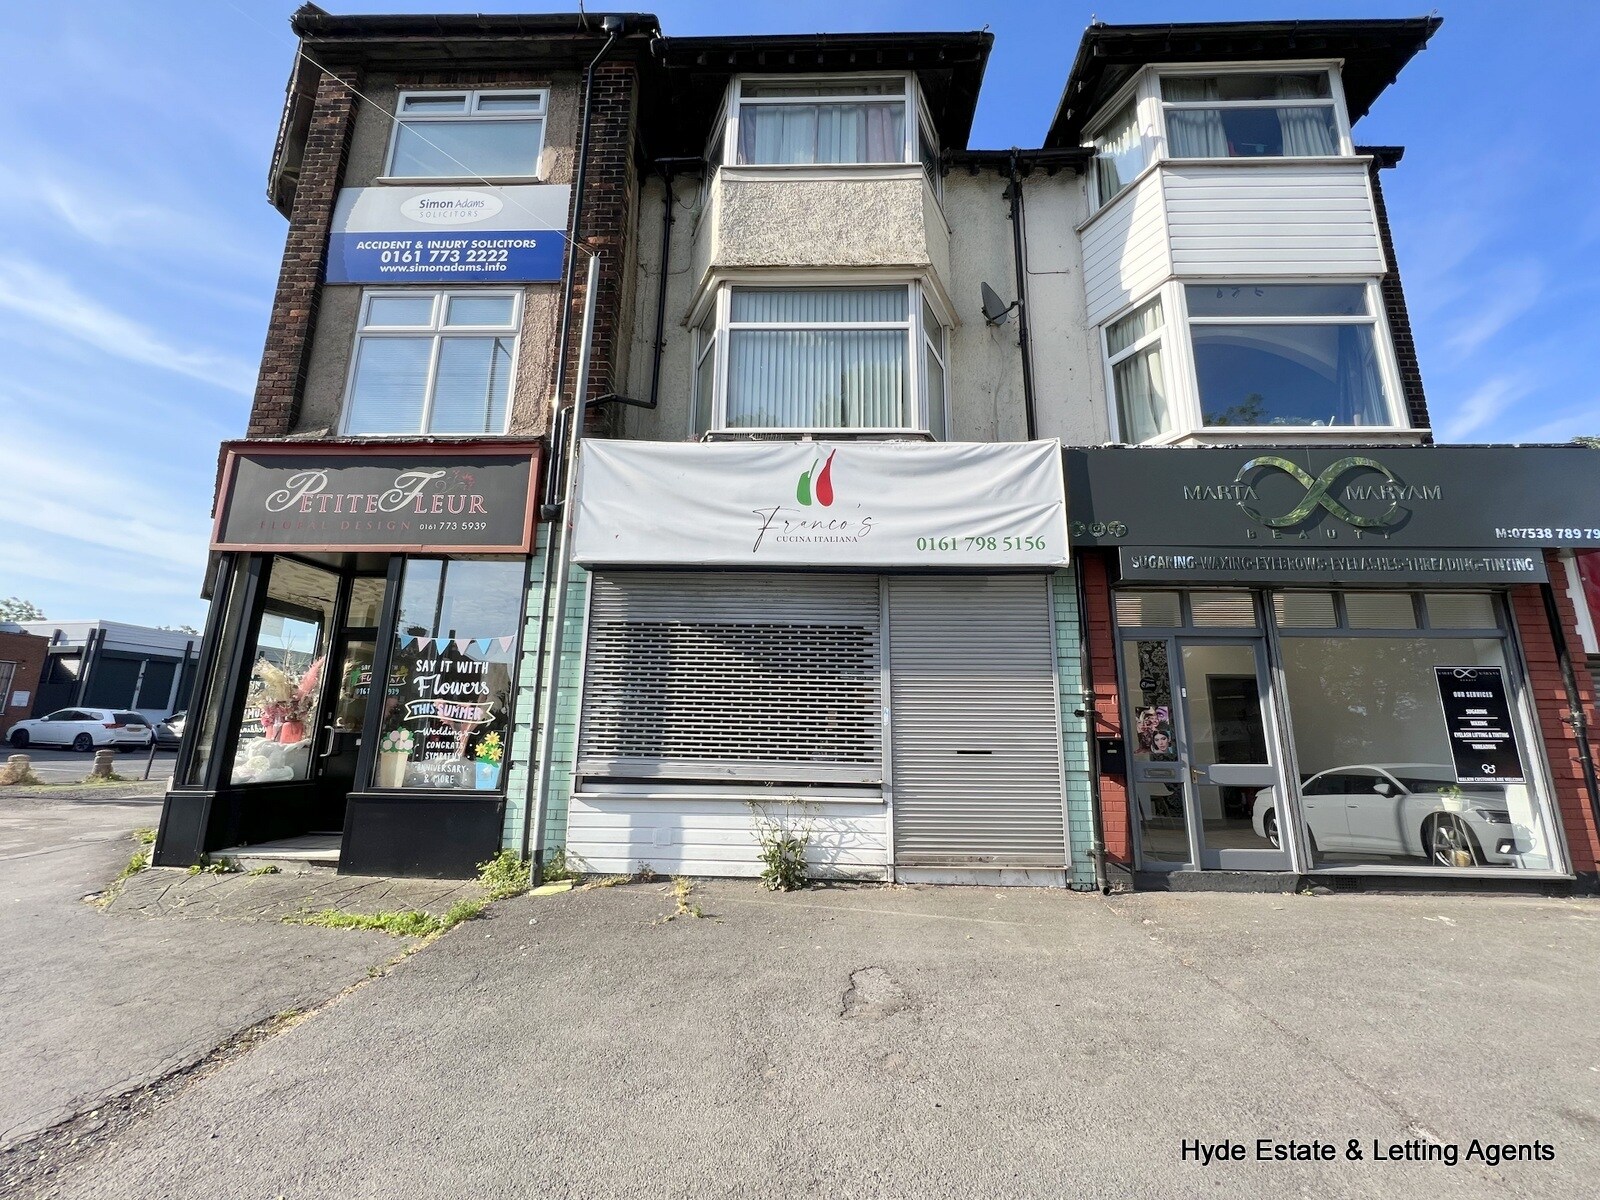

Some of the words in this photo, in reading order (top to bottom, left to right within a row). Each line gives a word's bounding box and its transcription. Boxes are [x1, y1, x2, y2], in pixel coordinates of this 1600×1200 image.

[419, 199, 453, 209] Simon
[454, 199, 485, 209] Adams
[419, 211, 479, 219] SOLICITORS
[356, 240, 412, 250] ACCIDENT
[415, 241, 424, 249] &
[427, 240, 468, 249] INJURY
[471, 239, 537, 249] SOLICITORS
[381, 250, 421, 263] 0161
[429, 250, 460, 263] 773
[466, 250, 509, 262] 2222
[379, 262, 507, 273] www.simonadams.info
[265, 469, 379, 514] PETITE
[377, 470, 488, 515] FLEUR
[1182, 484, 1260, 501] MARTA
[1345, 484, 1443, 501] MARYAM
[259, 520, 328, 531] FLORAL
[340, 520, 411, 530] DESIGN
[419, 523, 437, 531] 0161
[438, 522, 458, 531] 773
[461, 521, 487, 531] 5939
[752, 503, 880, 553] Franco's
[776, 535, 811, 543] CUCINA
[1246, 528, 1393, 540] BEAUTY
[1495, 527, 1552, 540] M:07538
[1555, 528, 1582, 540] 789
[916, 536, 958, 551] 0161
[964, 536, 997, 552] 798
[1003, 535, 1046, 552] 5156
[416, 660, 437, 672] SAY
[440, 660, 453, 672] IT
[456, 661, 489, 674] WITH
[413, 674, 490, 698] Flowers
[411, 703, 435, 715] THIS
[436, 704, 484, 720] SUMMER
[420, 726, 471, 741] Weddings
[426, 741, 464, 750] CONGRATS
[425, 751, 461, 761] SYMPATHY
[433, 774, 455, 784] MORE
